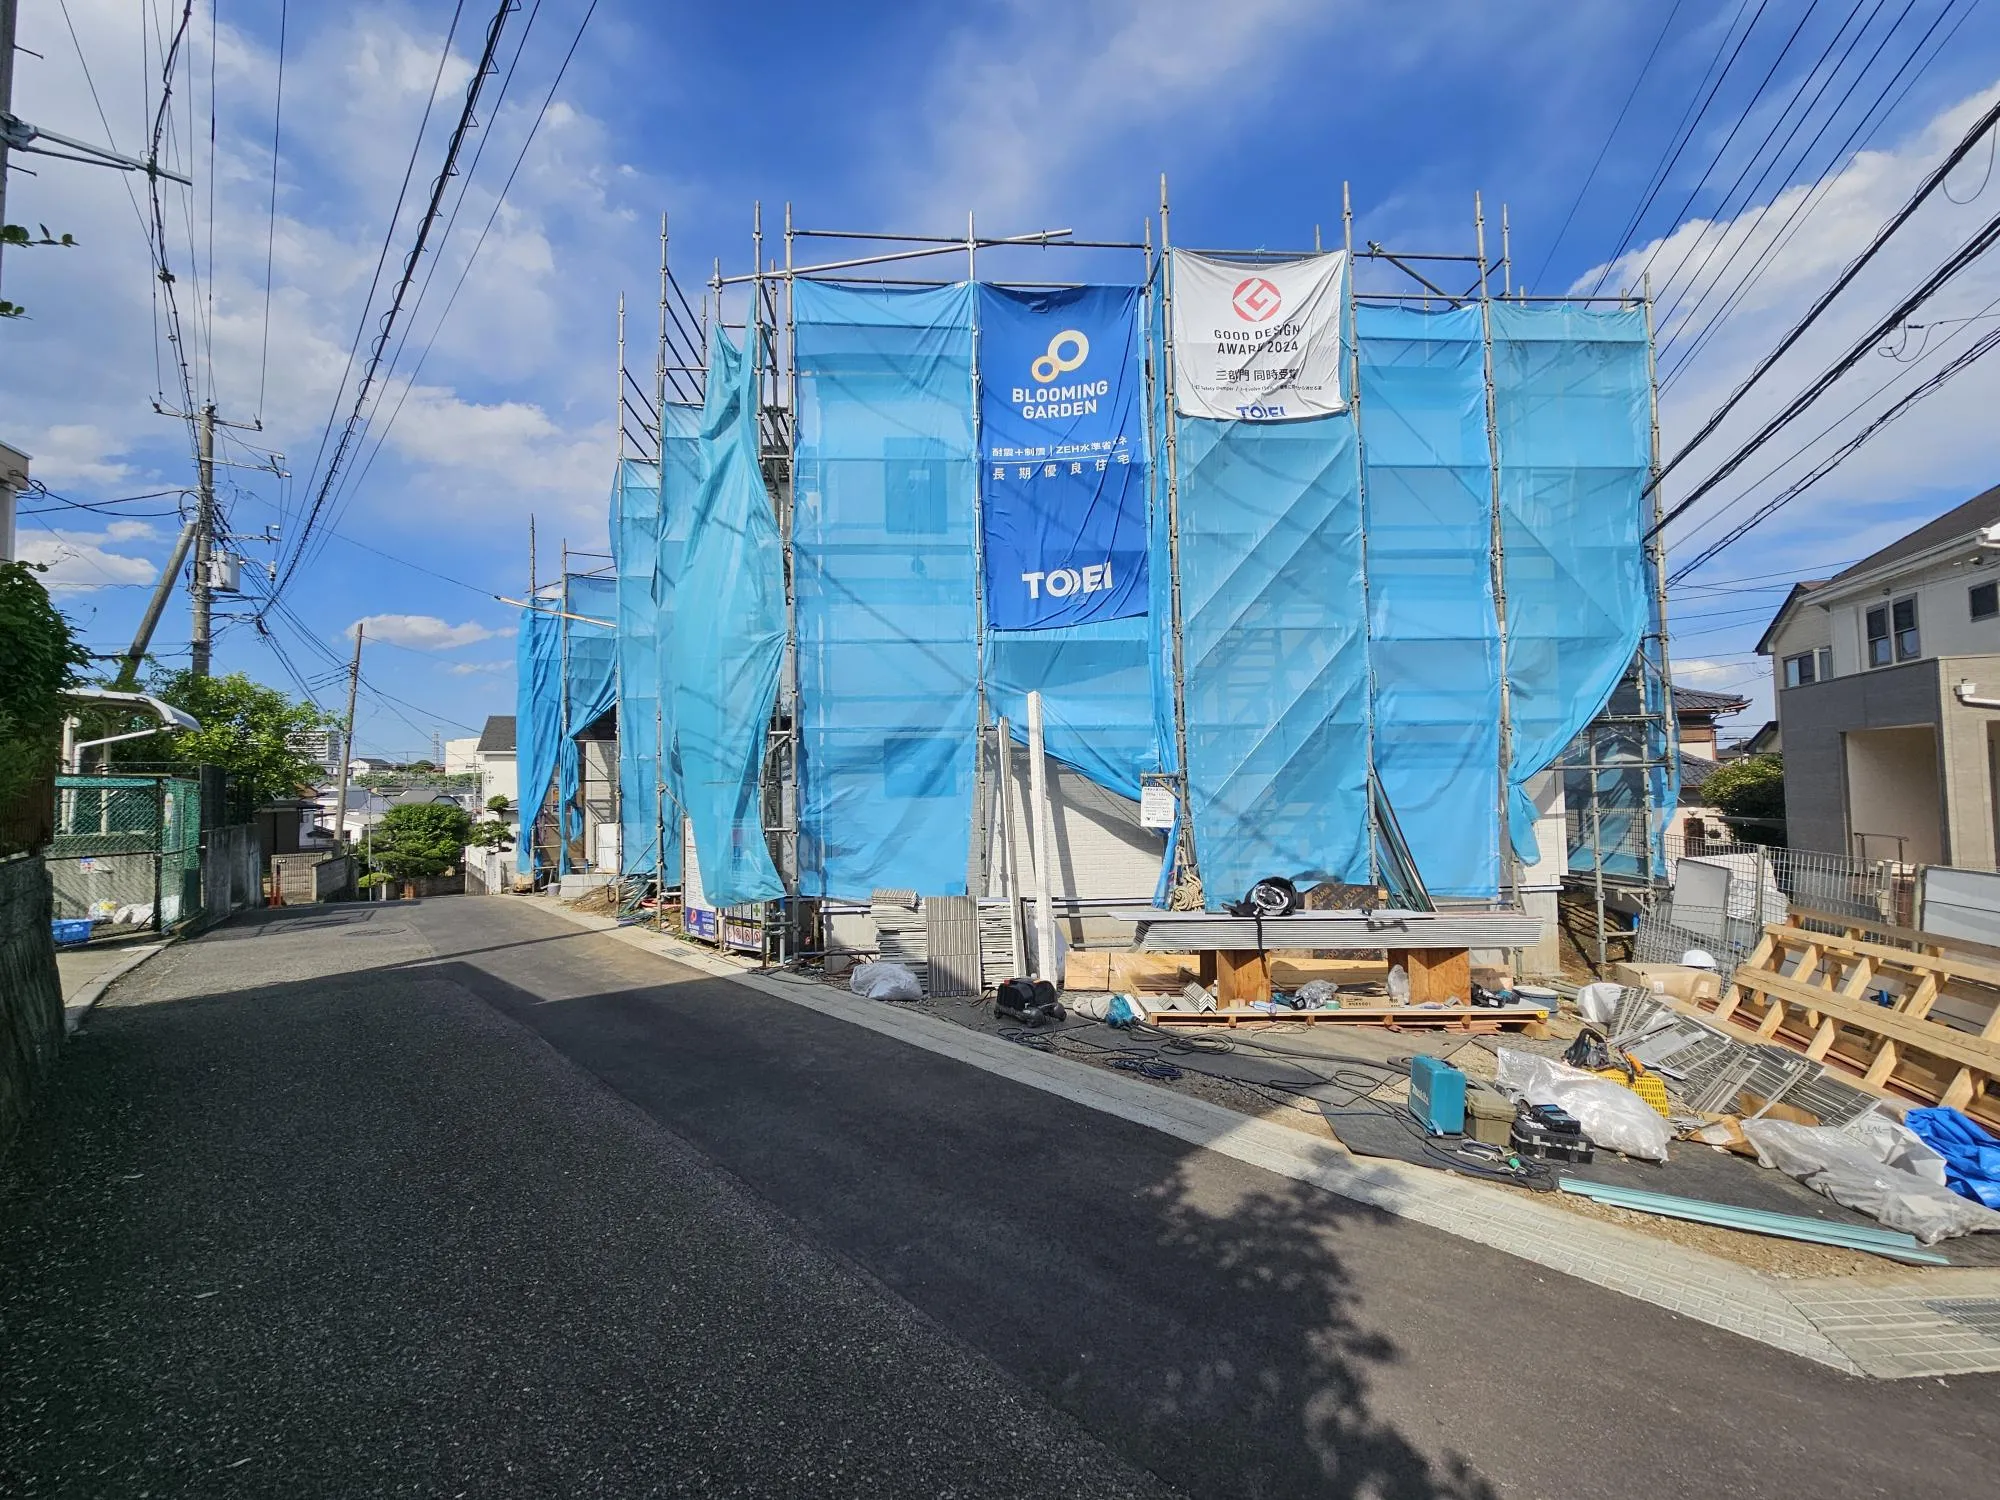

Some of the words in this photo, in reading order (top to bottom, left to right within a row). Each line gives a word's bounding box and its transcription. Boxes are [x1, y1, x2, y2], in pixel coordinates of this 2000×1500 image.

[1214, 329, 1250, 341] GOOD
[1255, 323, 1301, 339] DESIGN
[1267, 341, 1298, 353] 2024
[1216, 368, 1250, 382] 三部門
[1012, 380, 1108, 403] BLOOMING
[1022, 399, 1098, 419] GARDEN
[1056, 436, 1128, 454] ZEH水準省ネ
[992, 454, 1130, 481] 長期優良住宅
[1022, 562, 1113, 600] TOEI
